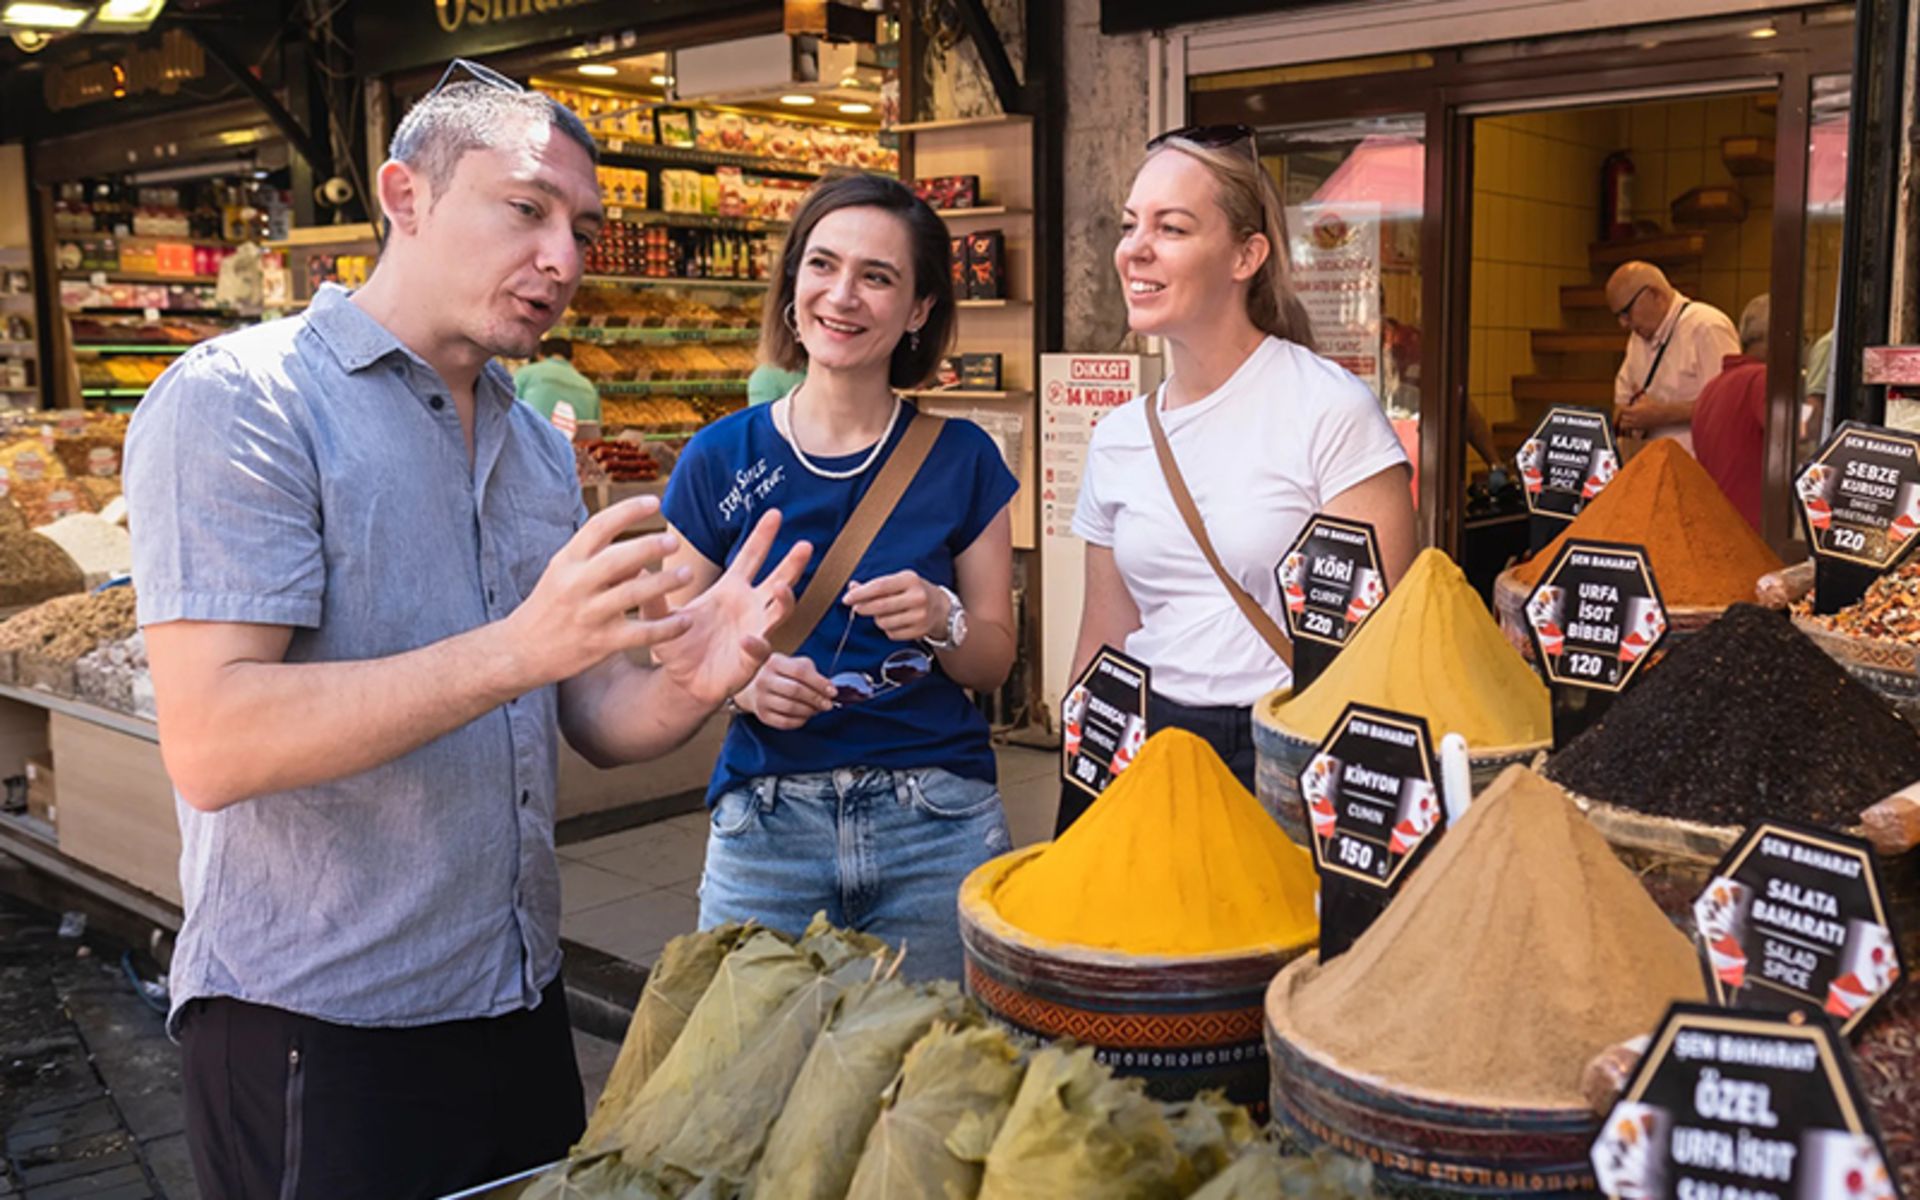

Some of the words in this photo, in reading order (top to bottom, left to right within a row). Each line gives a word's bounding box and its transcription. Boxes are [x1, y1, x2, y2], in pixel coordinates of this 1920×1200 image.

[1067, 388, 1082, 406] 14
[1550, 434, 1592, 452] KAJUN
[1866, 439, 1913, 457] BAHARAT
[1550, 478, 1575, 489] SPICE
[1845, 460, 1900, 485] SEBZE
[1840, 478, 1897, 499] KURUSU
[1833, 528, 1866, 550] 120
[1591, 556, 1638, 571] BAHARAT
[1309, 588, 1344, 605] CURRY
[1578, 583, 1618, 602] URFA
[1578, 600, 1613, 621] İSOT
[1304, 612, 1333, 635] 220
[1567, 622, 1619, 644] BİBERİ
[1569, 653, 1602, 676] 120
[1369, 724, 1417, 747] BAHARAT
[1343, 763, 1400, 795] KİMYON
[1347, 802, 1385, 825] CUMIN
[1338, 836, 1373, 870] 150
[1761, 836, 1791, 858] ŞEN
[1791, 845, 1863, 879] BAHARAT
[1766, 878, 1839, 917] SALATA
[1751, 898, 1847, 946] BAHARATI
[1764, 939, 1818, 972] SALAD
[1762, 958, 1811, 990] SPICE
[1717, 1035, 1818, 1073] BAHARAT
[1695, 1065, 1779, 1129] ÖZEL
[1671, 1125, 1736, 1173] URFA
[1735, 1127, 1797, 1182] İSOT
